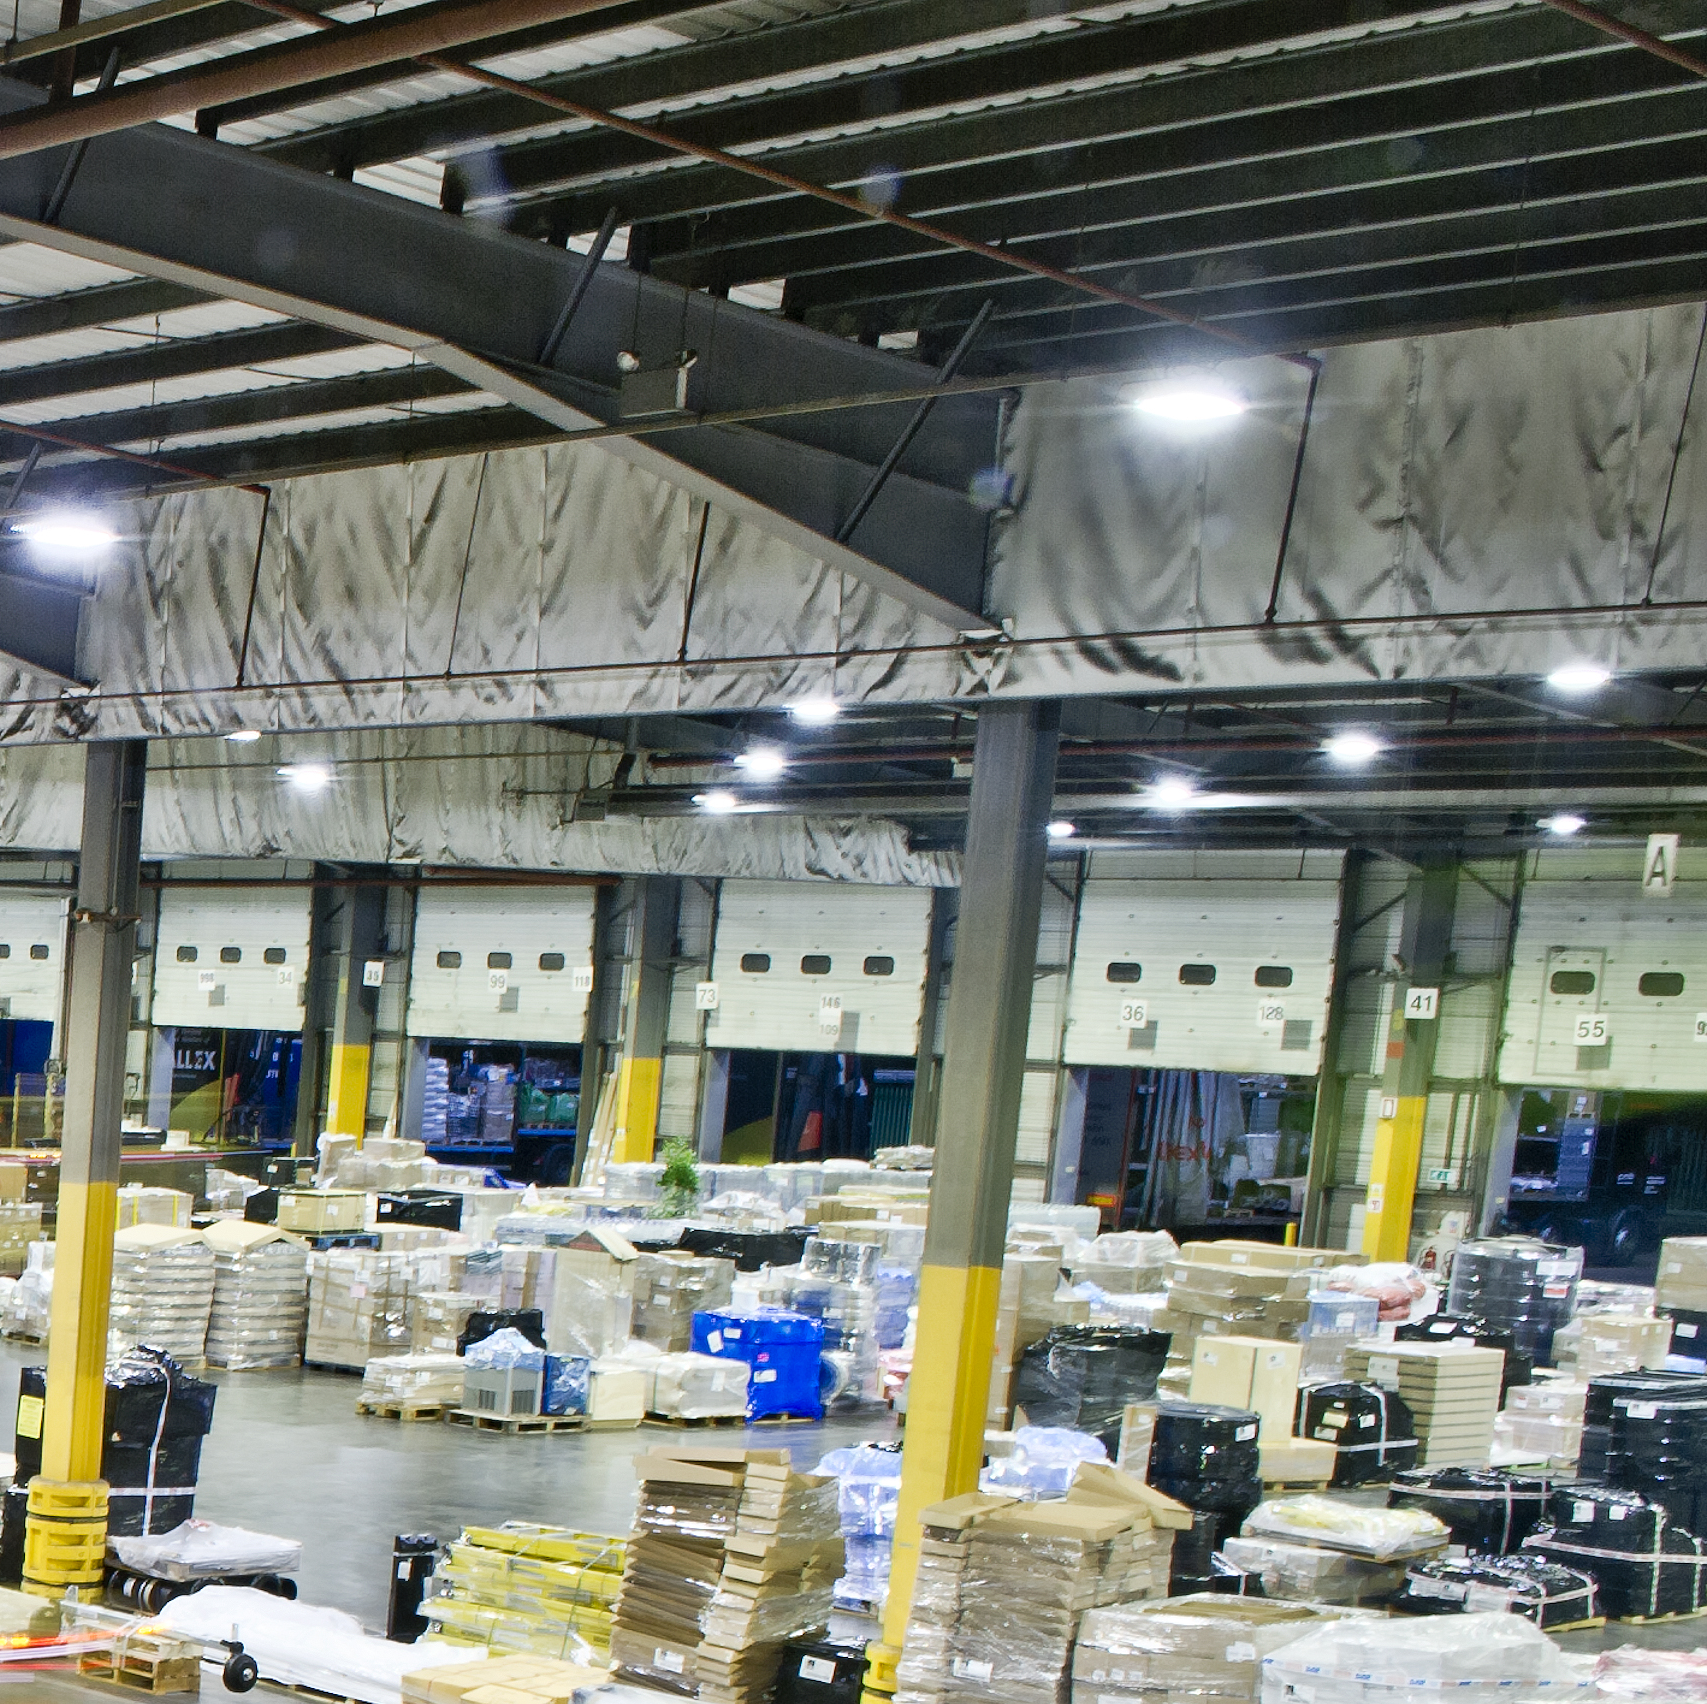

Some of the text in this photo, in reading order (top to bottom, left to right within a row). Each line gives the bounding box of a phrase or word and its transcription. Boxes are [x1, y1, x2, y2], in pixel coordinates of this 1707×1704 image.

[1645, 845, 1667, 887] A
[278, 971, 292, 984] 34
[490, 975, 506, 988] 99
[699, 988, 715, 1003] 73
[1410, 995, 1432, 1011] 41
[1122, 1005, 1144, 1021] 36
[1258, 1007, 1284, 1021] 128
[820, 1023, 838, 1036] 109
[1577, 1020, 1604, 1037] 55
[1697, 1021, 1707, 1035] 9
